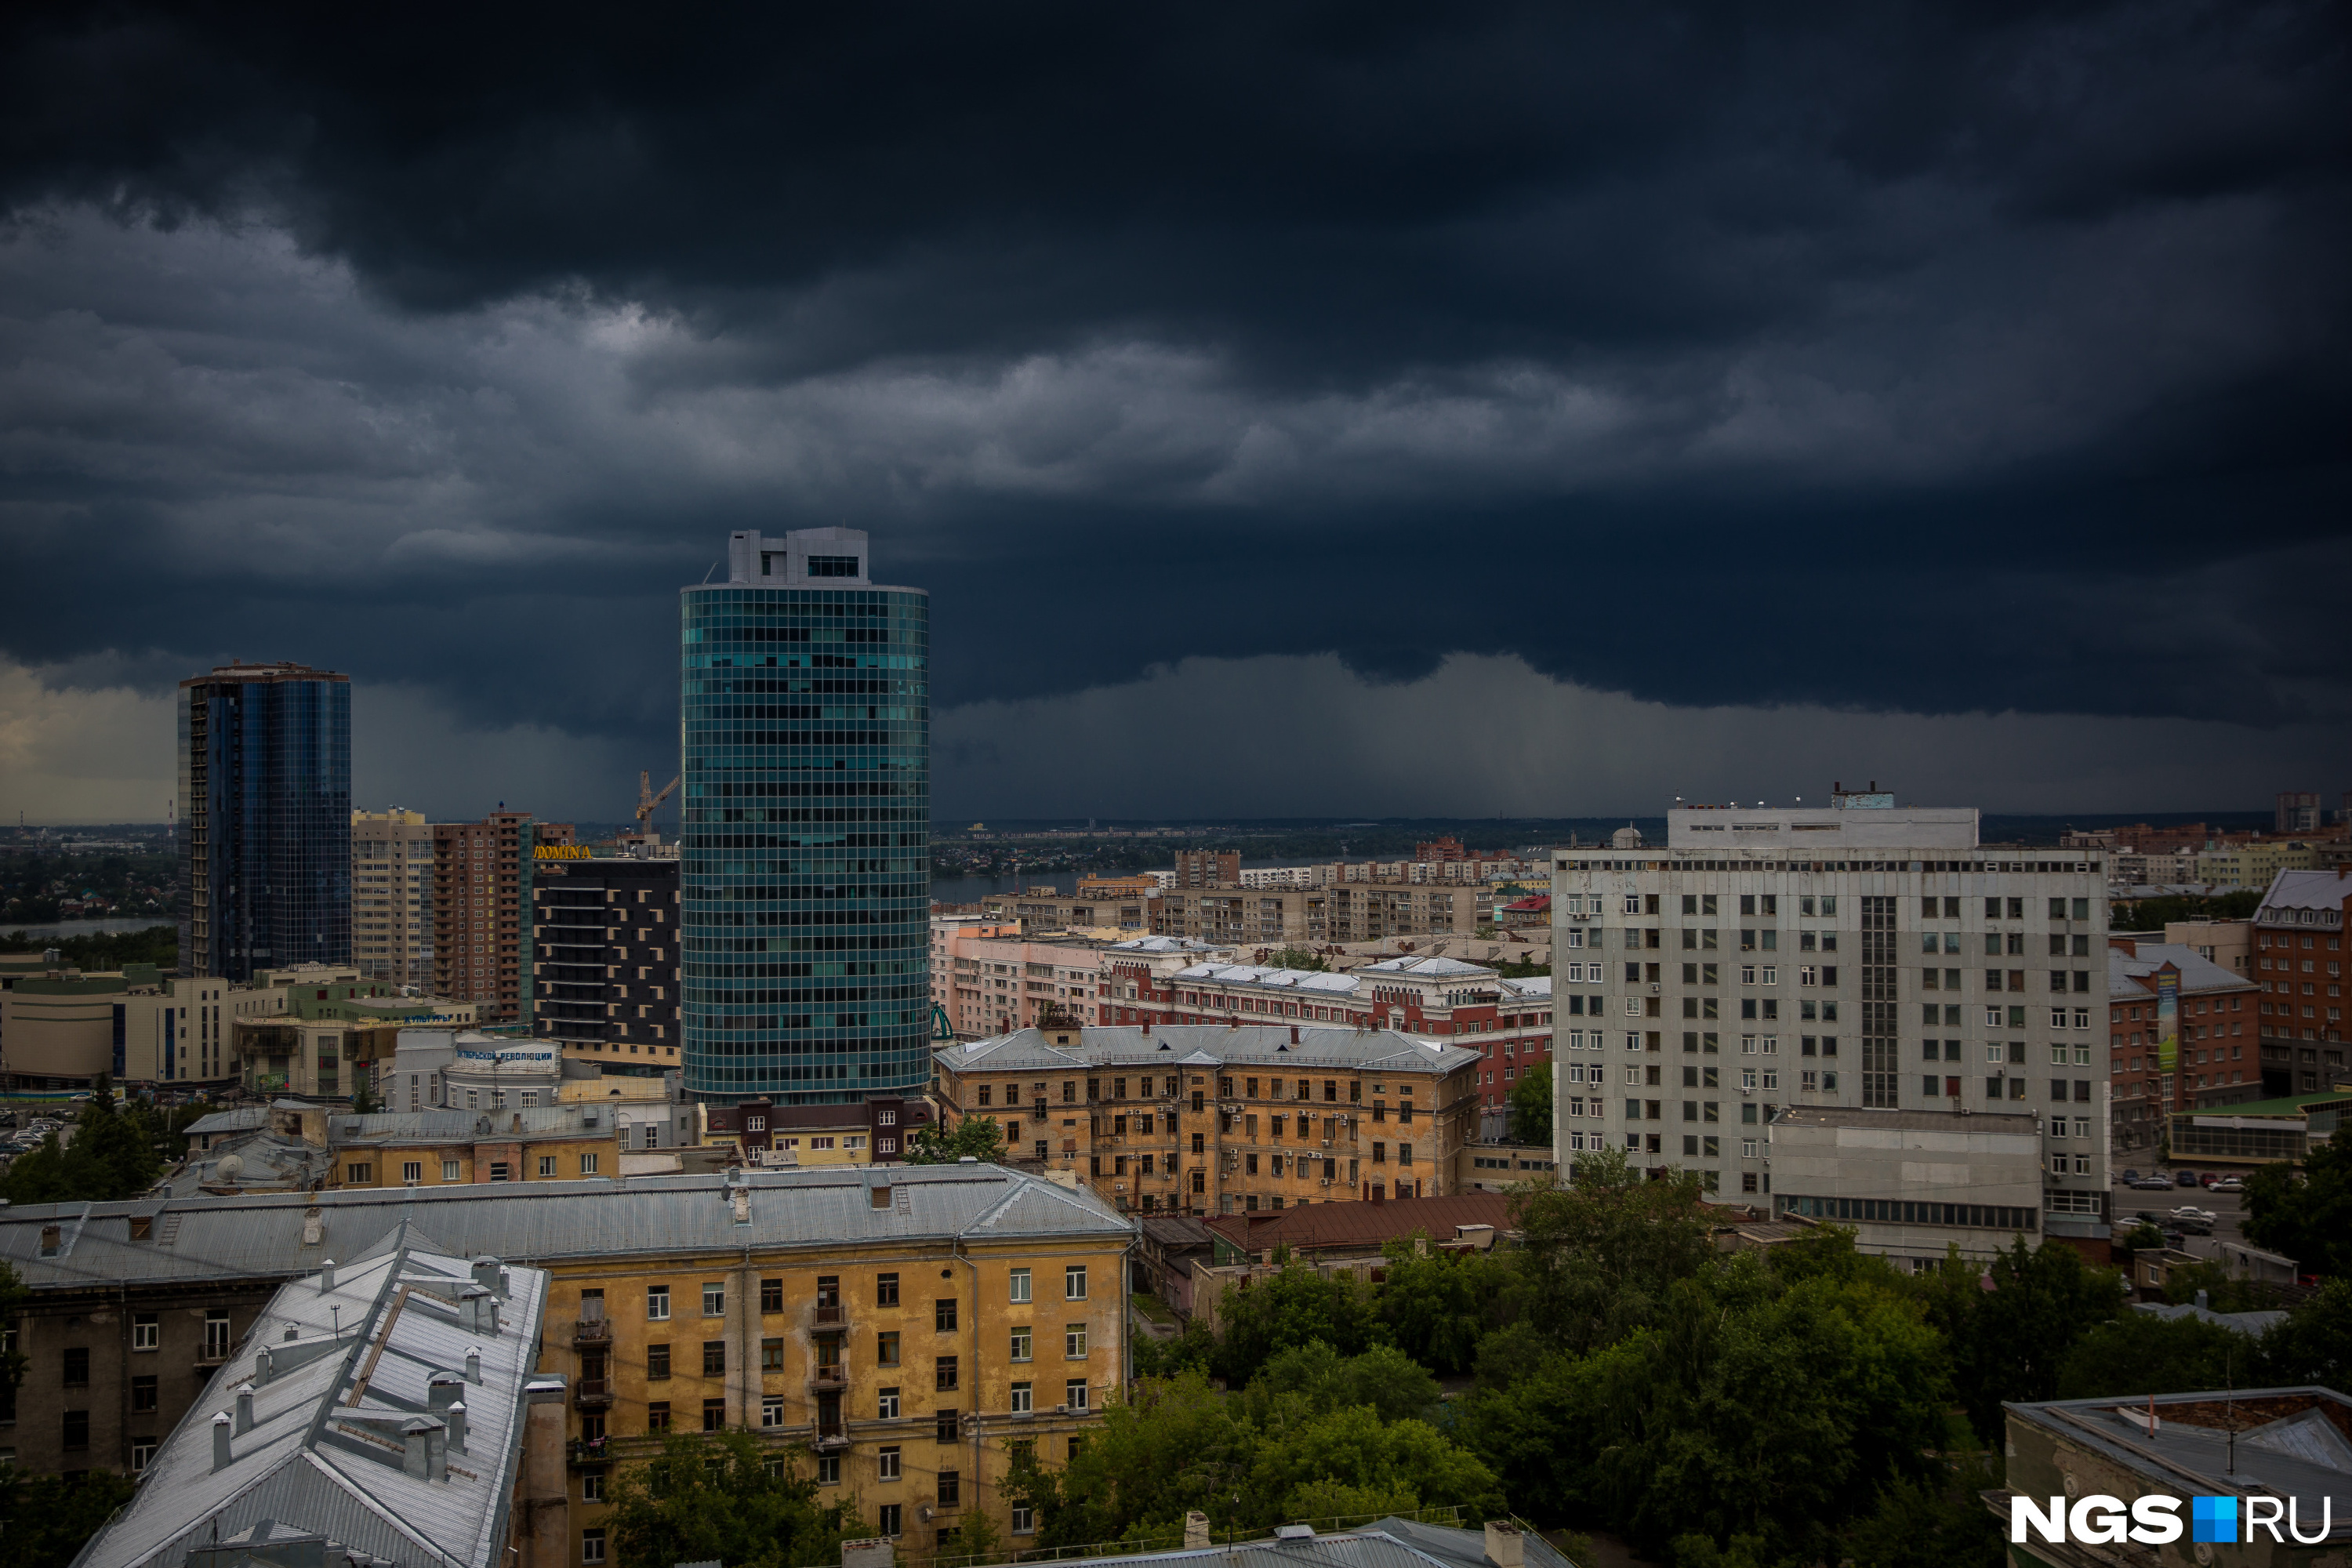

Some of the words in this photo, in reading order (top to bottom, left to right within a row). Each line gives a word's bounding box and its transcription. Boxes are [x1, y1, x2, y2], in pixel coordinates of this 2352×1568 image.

[537, 845, 593, 859] DOMINA
[405, 1014, 452, 1023] КУЛЬТУРЫ
[457, 1050, 496, 1060] ОКТЯБРЬСКОЙ
[501, 1052, 552, 1062] РЕВОЛЮЦИИ
[271, 1074, 285, 1083] SALE
